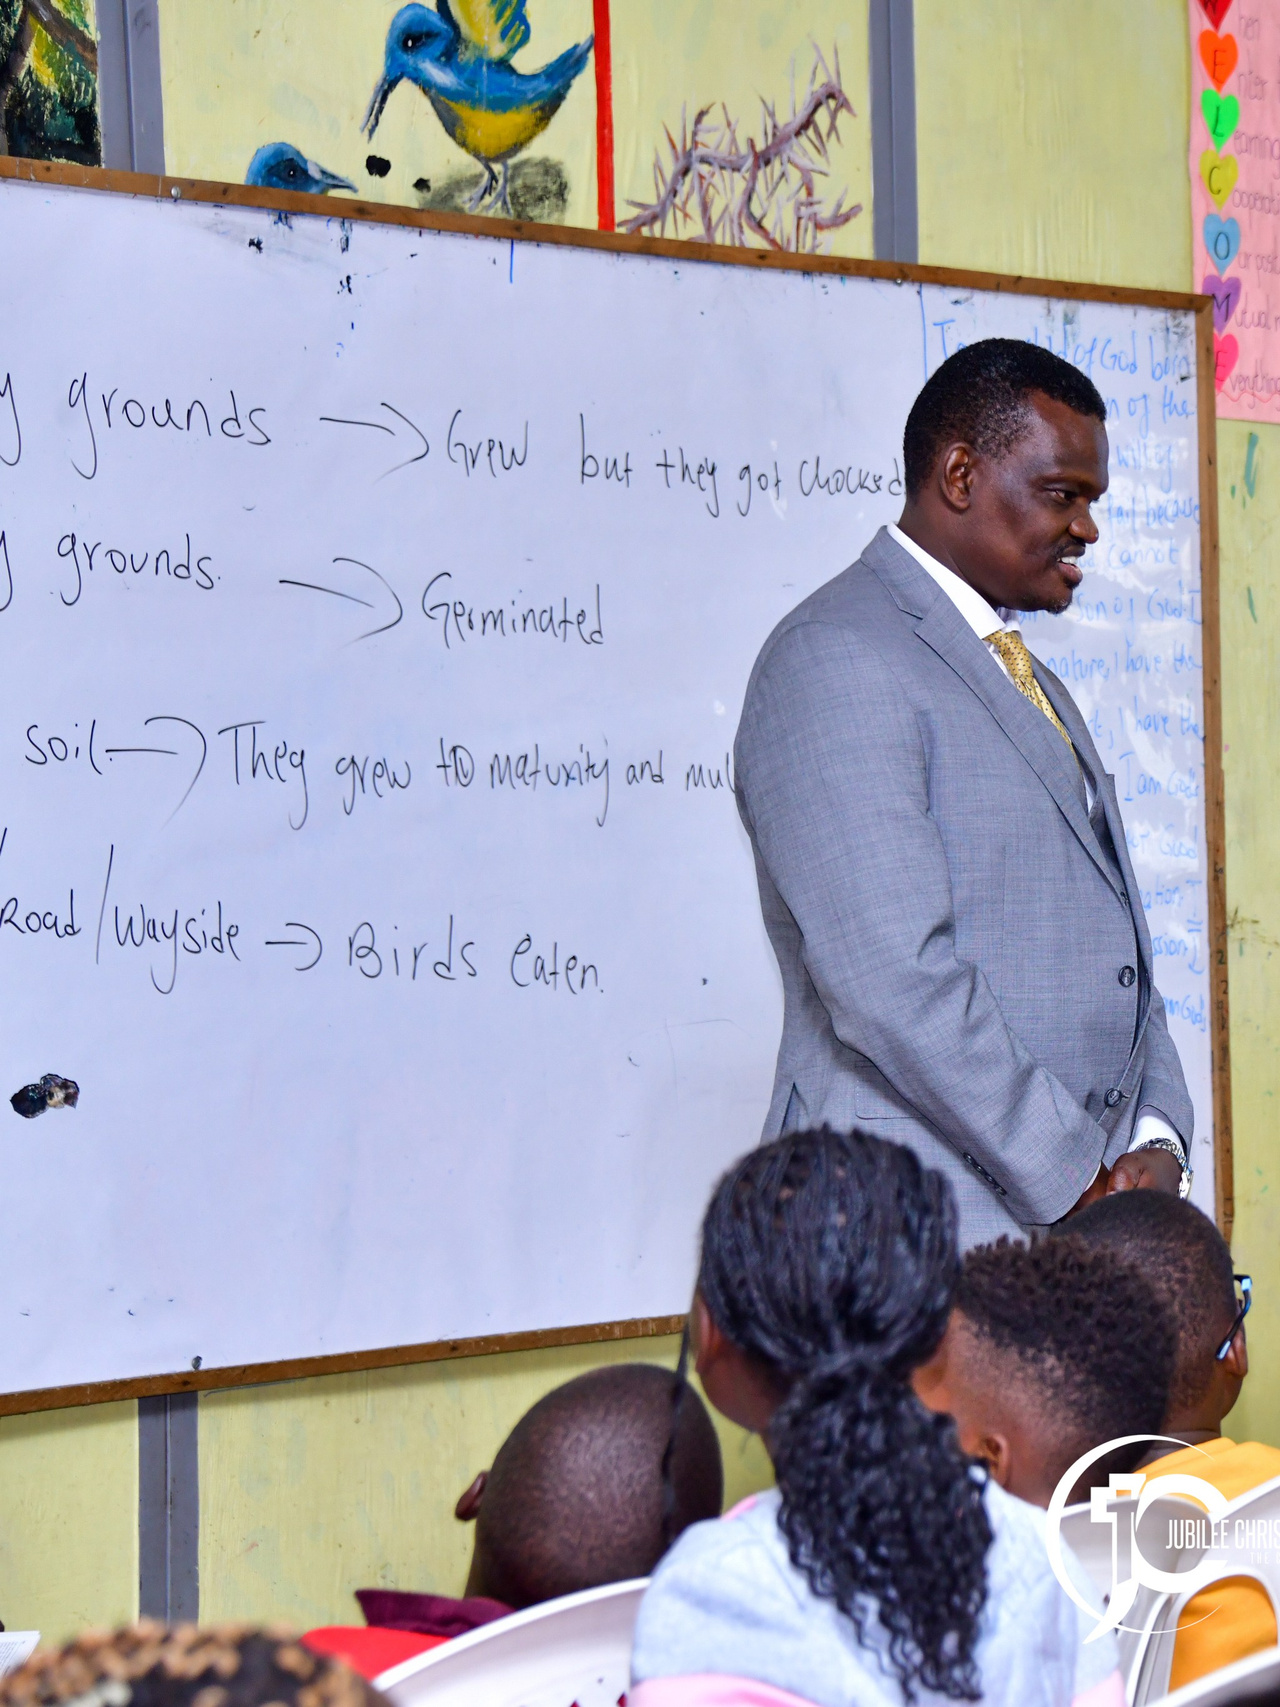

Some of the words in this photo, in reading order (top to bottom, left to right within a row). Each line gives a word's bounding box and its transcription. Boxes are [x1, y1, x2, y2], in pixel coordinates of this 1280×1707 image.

[1100, 328, 1138, 375] God
[69, 372, 271, 480] grounds
[447, 409, 529, 477] Grew
[580, 413, 634, 487] but
[656, 447, 719, 518] they
[739, 463, 782, 518] got
[422, 572, 604, 649] Germinated
[335, 754, 412, 816] grew
[490, 738, 610, 828] maturity
[626, 750, 665, 785] and
[348, 914, 478, 981] Birds
